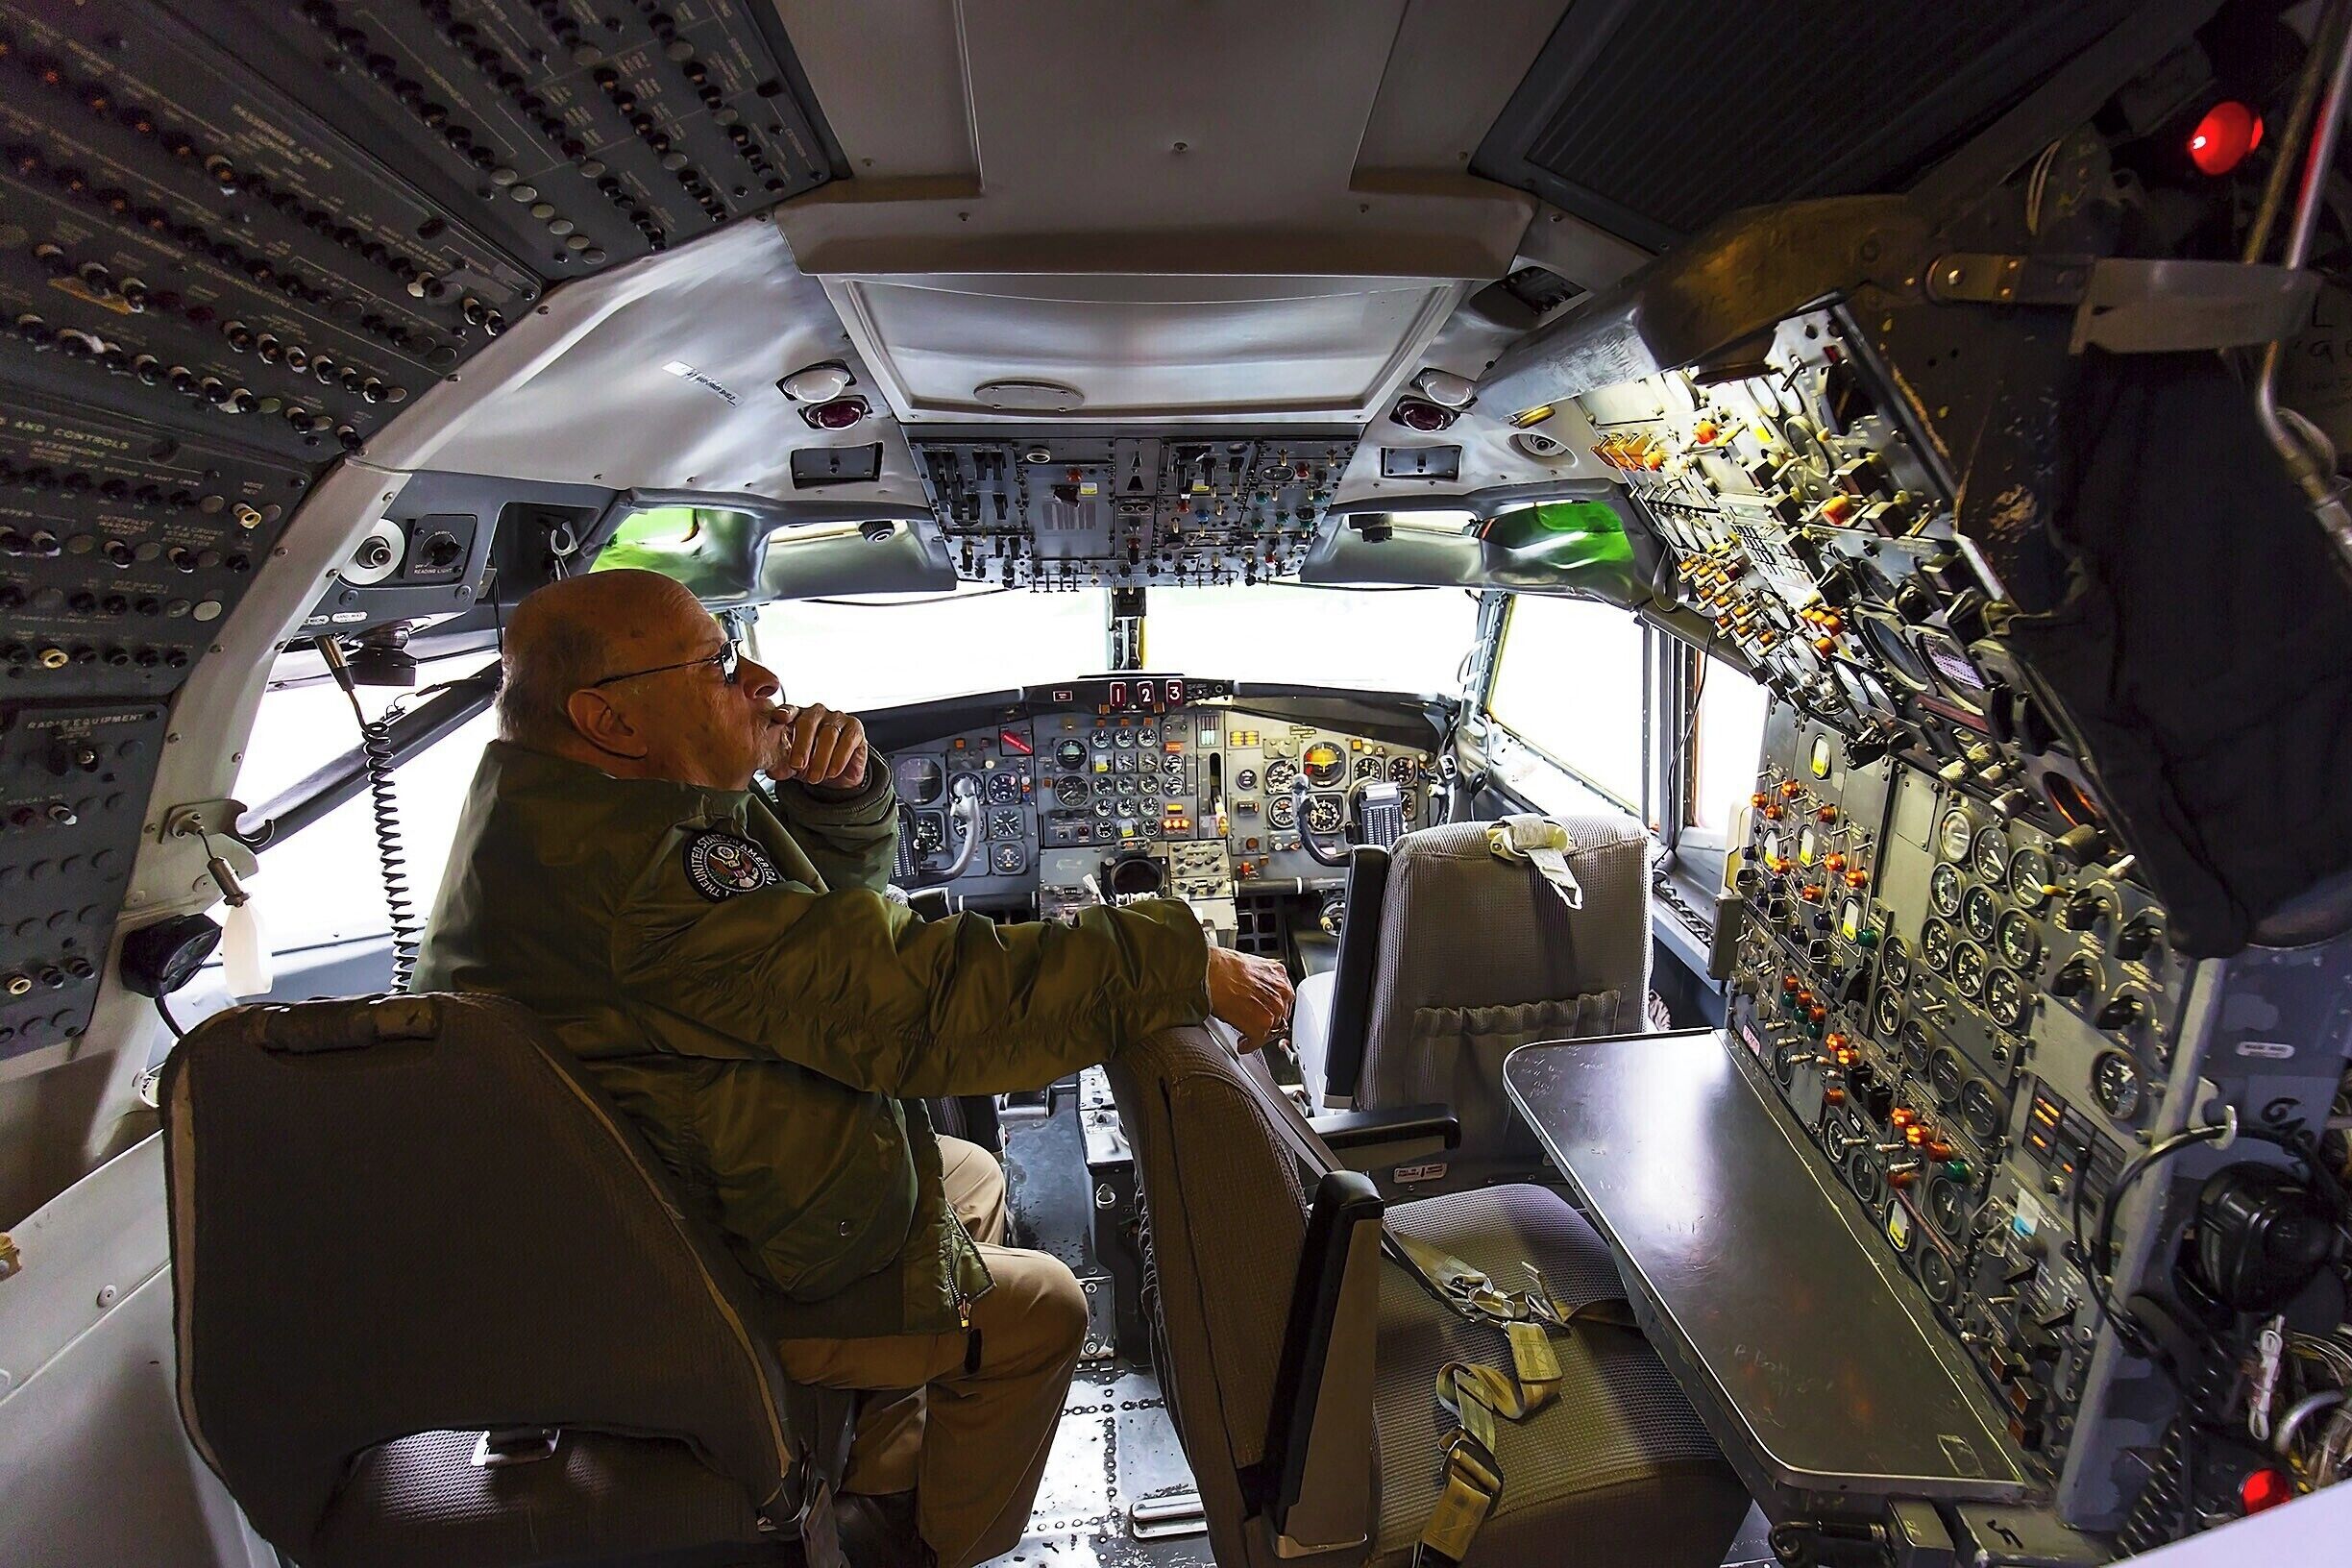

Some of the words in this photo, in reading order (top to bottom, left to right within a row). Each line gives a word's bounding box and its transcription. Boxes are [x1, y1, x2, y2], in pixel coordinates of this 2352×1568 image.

[53, 428, 131, 451] CONTROLS
[143, 473, 175, 483] FLIGHT
[1115, 688, 1121, 702] 1
[1141, 688, 1151, 702] 2
[1169, 686, 1181, 700] 3
[27, 719, 69, 730] RADIO
[73, 713, 144, 727] EQUIPMENT
[691, 847, 708, 882] UNITED
[739, 844, 777, 886] AMERICA
[699, 880, 721, 897] THE
